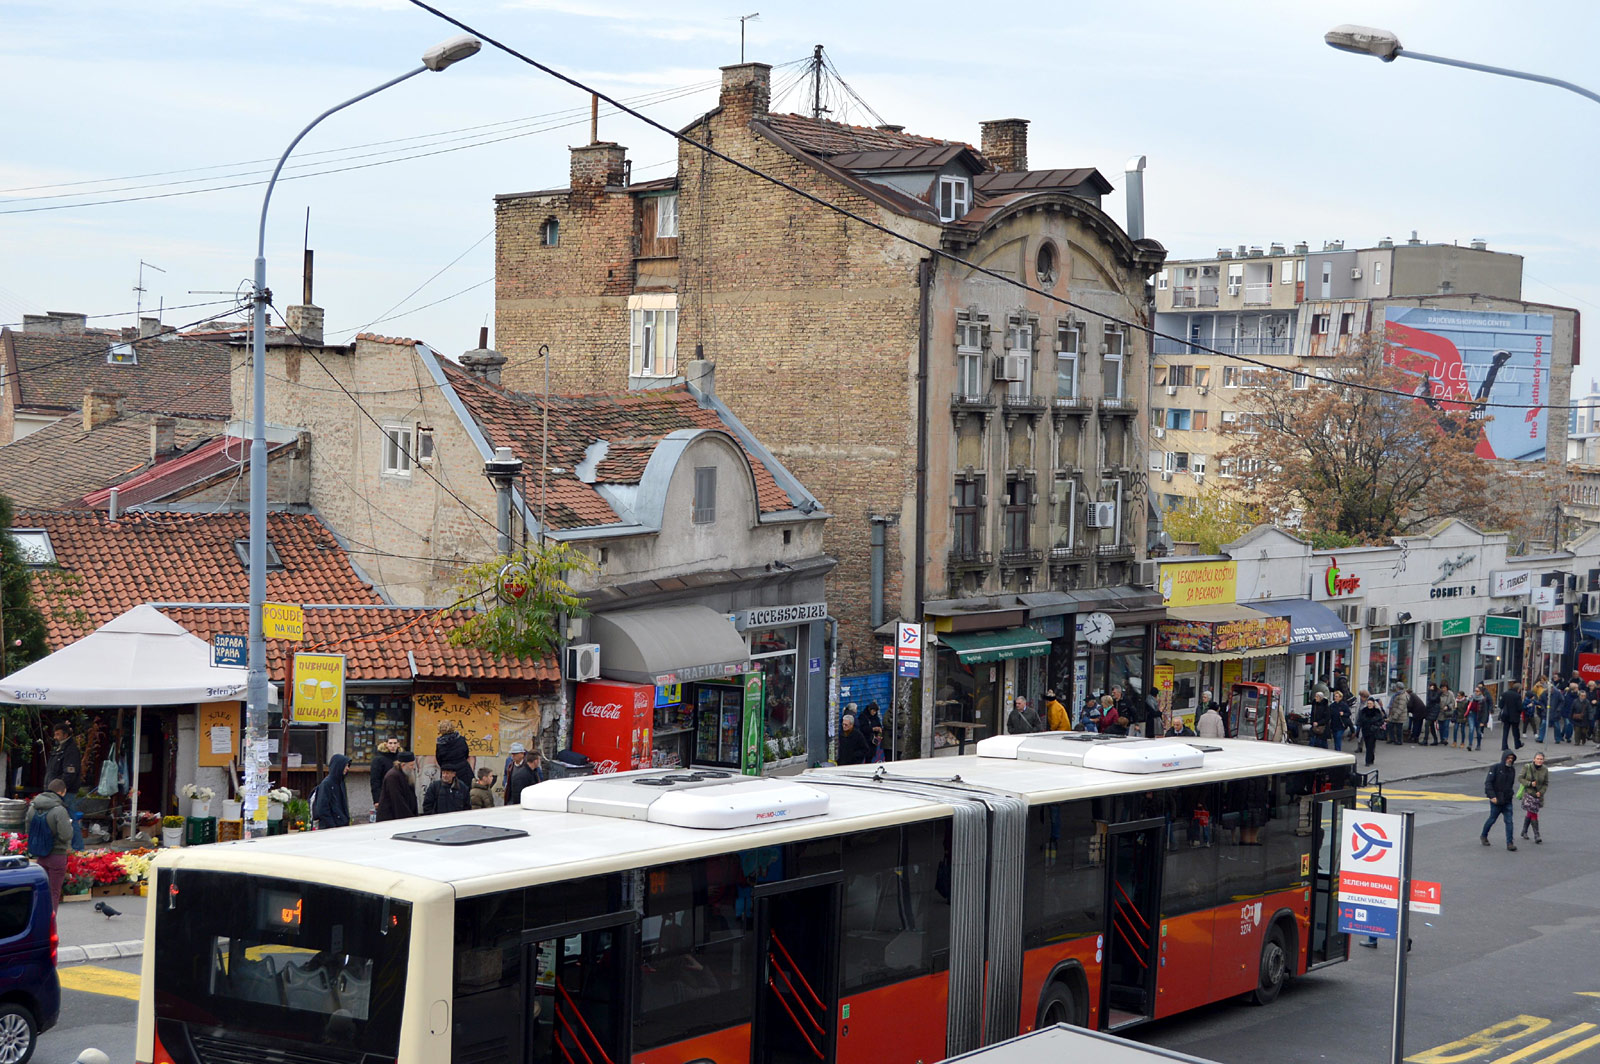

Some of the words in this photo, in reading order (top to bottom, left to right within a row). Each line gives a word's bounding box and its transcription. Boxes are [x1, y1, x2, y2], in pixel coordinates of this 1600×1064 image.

[1456, 318, 1487, 327] SHOPPING
[1488, 319, 1511, 328] CENTER
[1533, 336, 1543, 358] foot
[1432, 361, 1444, 380] U
[1532, 364, 1541, 405] athlete's
[1529, 421, 1538, 439] the
[1506, 573, 1529, 589] TURKISH
[1186, 588, 1195, 601] SA
[1195, 586, 1225, 601] PEKAROM
[1430, 585, 1476, 599] COSMETS
[264, 607, 302, 622] POSUĐE
[748, 604, 825, 625] ACCESSORIZE
[274, 624, 286, 633] NA
[287, 624, 301, 635] KILO
[215, 636, 244, 648] ЗДРАВА
[216, 648, 241, 659] ХРАНА
[298, 661, 341, 674] ПИВНИЦА
[677, 663, 723, 680] TRAFIKA
[14, 689, 38, 700] Jelen
[206, 687, 229, 698] Jelen
[208, 711, 231, 721] ХЛЕБ
[296, 707, 339, 720] ШИНДРА
[443, 703, 473, 716] ХЛЕБ
[1343, 878, 1370, 887] ЗЕЛЕНИ
[1370, 882, 1393, 891] ВЕНАЦ
[1347, 895, 1367, 903] ZELENI
[1428, 887, 1435, 899] 1
